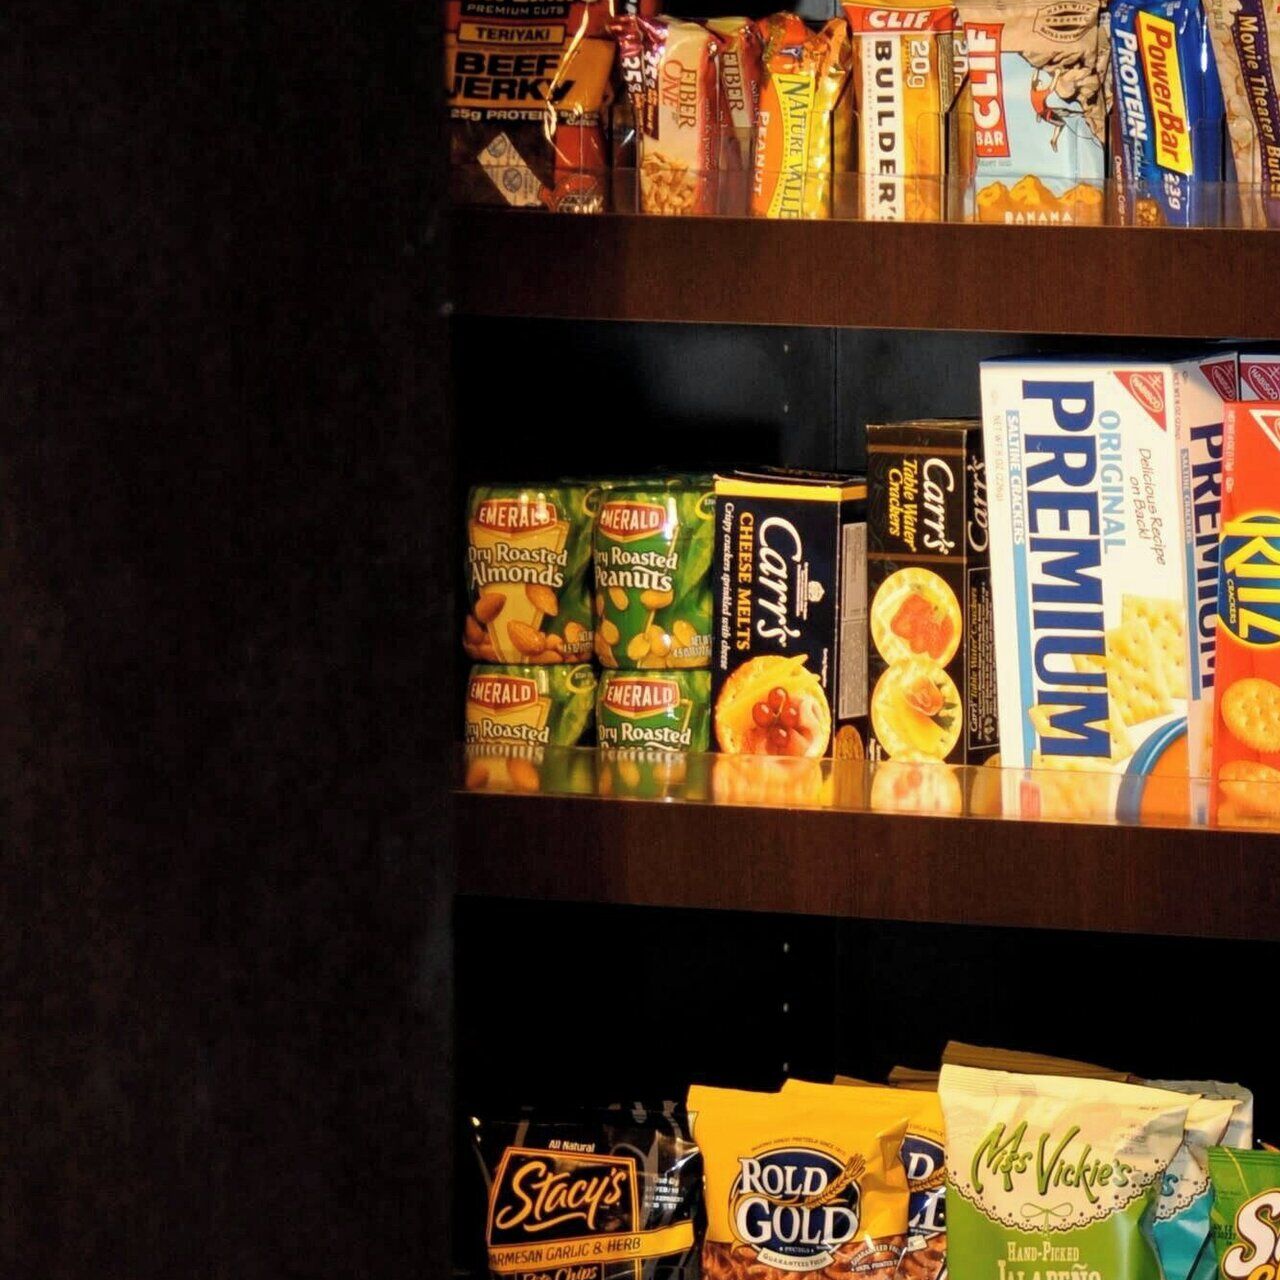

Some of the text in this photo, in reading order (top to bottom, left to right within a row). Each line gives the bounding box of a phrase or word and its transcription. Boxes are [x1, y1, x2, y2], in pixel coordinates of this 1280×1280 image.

[467, 4, 564, 15] PREMIUM CUTS
[476, 27, 549, 41] TERIYAKI
[868, 11, 930, 29] CLIF
[456, 51, 561, 76] BEEF
[664, 59, 683, 108] ONE
[722, 51, 745, 111] FIBER
[906, 40, 930, 90] 20g
[967, 28, 1001, 129] CLIF
[1115, 28, 1148, 141] PROTEIN
[1239, 16, 1262, 68] Movie
[1252, 74, 1275, 143] Theater
[450, 76, 576, 103] JERKY
[678, 69, 698, 129] FIBER
[1145, 23, 1186, 165] PowerBar
[486, 109, 556, 120] PROTEIN
[777, 75, 811, 156] NATURE
[975, 131, 1005, 147] BAR
[754, 111, 770, 195] PEANUT
[779, 162, 803, 218] VALLE
[1004, 210, 1074, 225] BANANA
[1131, 376, 1163, 411] NABISCO
[1249, 364, 1280, 401] NABISCO
[888, 468, 905, 537] Crackers
[1007, 414, 1025, 545] SALTINE CRACKERS
[1098, 409, 1126, 554] ORIGINAL
[479, 506, 551, 528] EMERALD
[901, 459, 919, 552] Table Water
[922, 458, 955, 556] Carr's
[1129, 476, 1149, 540] on Back!
[1138, 447, 1167, 565] Delicious Recipe
[468, 543, 568, 567] Dry Roasted
[611, 546, 679, 570] Roasted
[722, 501, 735, 570] Crispy crackers
[470, 561, 564, 590] Almonds
[595, 566, 674, 592] Peanuts
[736, 512, 754, 650] CHEESE MELTS
[756, 516, 802, 648] Carr's
[1022, 379, 1113, 759] PREMIUM
[1227, 578, 1237, 624] CRACKERS
[471, 682, 532, 704] EMERALD
[607, 685, 674, 707] EMERALD
[483, 718, 550, 744] Roasted
[600, 722, 691, 745] Dry Roasted
[562, 1140, 595, 1153] Natural
[971, 1121, 1036, 1193] Miss
[1028, 1124, 1132, 1203] Vickie's
[496, 1161, 627, 1231] Stacy's
[737, 1157, 829, 1199] ROLD
[736, 1196, 860, 1245] GOLD
[543, 1237, 641, 1261] GARLIC & HERB
[1006, 1241, 1080, 1262] HAND-PICKED
